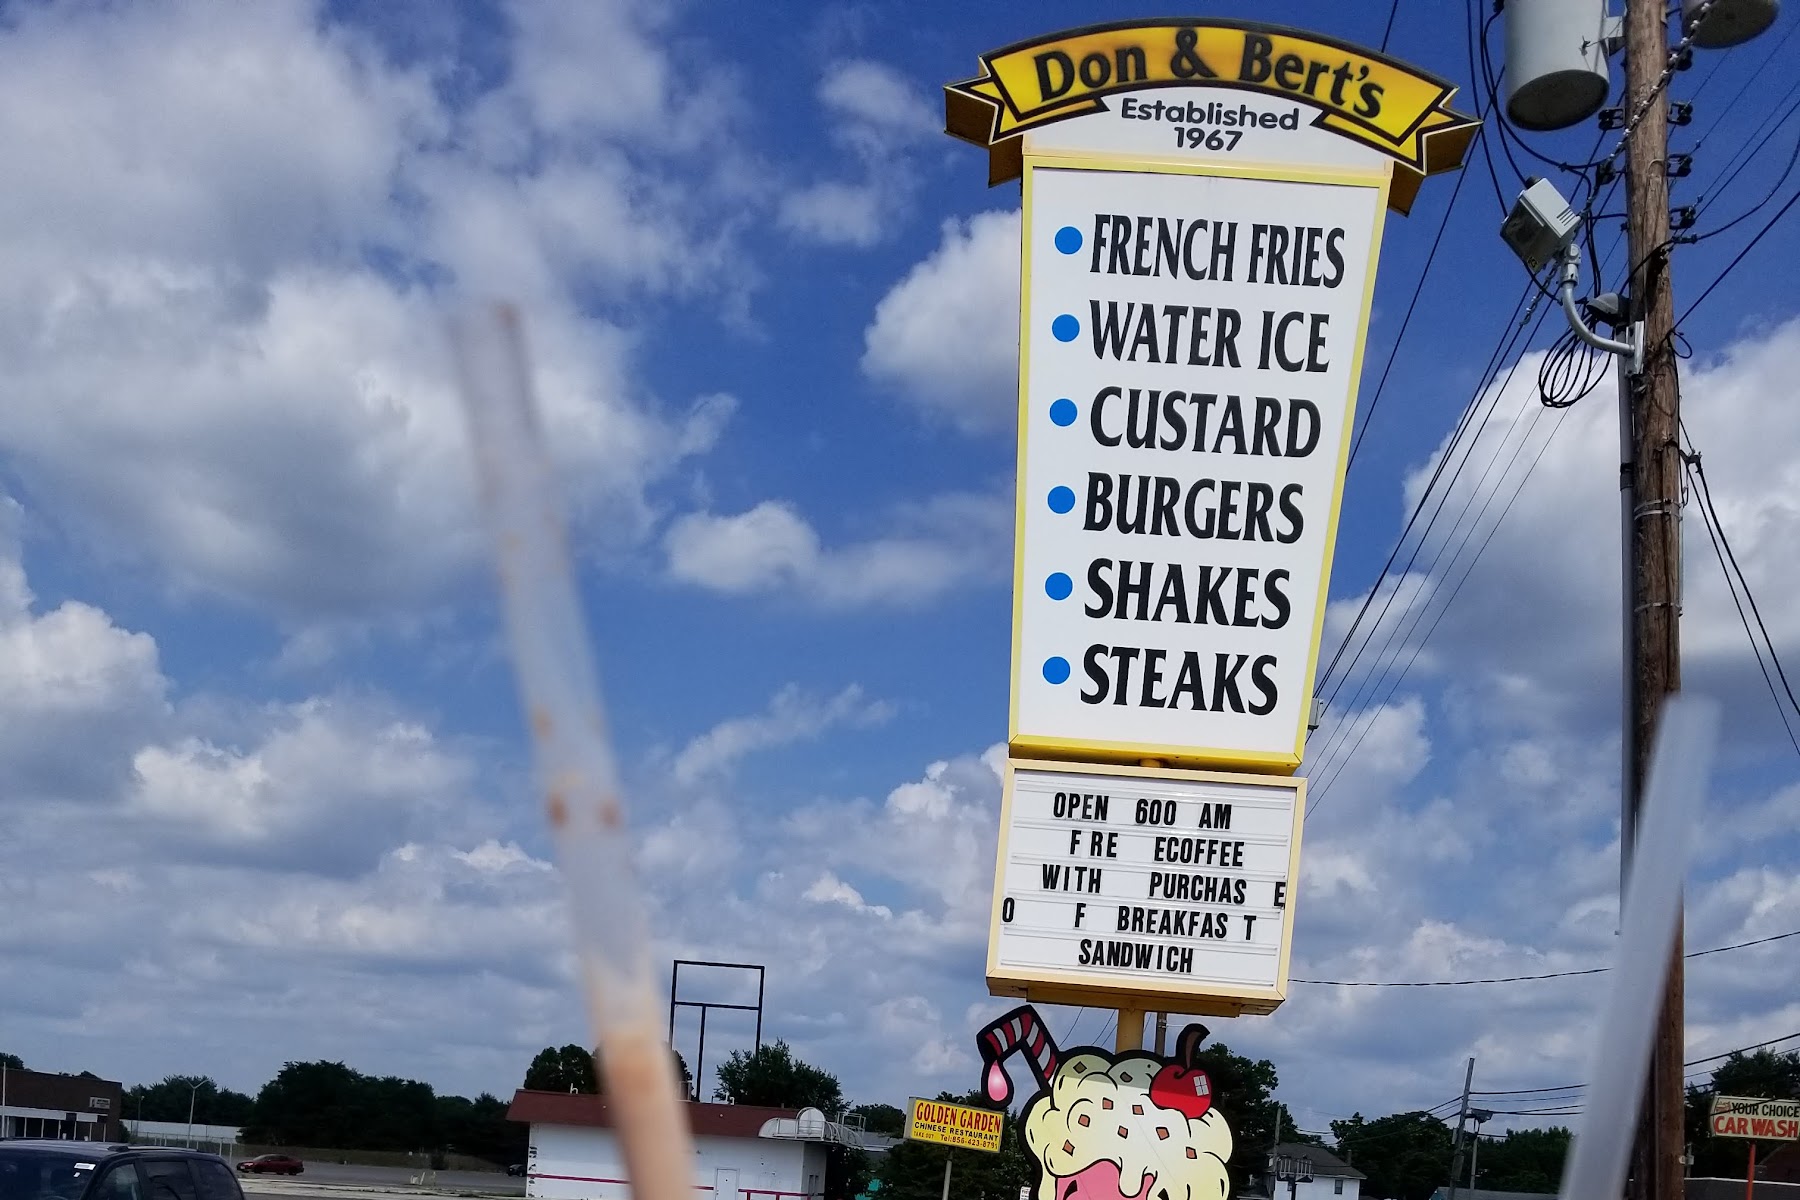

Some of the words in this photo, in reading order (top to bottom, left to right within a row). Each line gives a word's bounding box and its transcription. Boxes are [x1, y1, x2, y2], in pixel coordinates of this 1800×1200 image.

[1034, 45, 1147, 102] Don
[1170, 28, 1216, 78] &
[1239, 33, 1384, 119] Bert's
[1120, 98, 1299, 130] Established
[1174, 126, 1243, 151] 1967
[1090, 214, 1237, 281] FRENCH
[1247, 224, 1345, 289] FRIES
[1090, 300, 1241, 368] WATER
[1258, 310, 1329, 373] ICE
[1090, 386, 1321, 458] CUSTARD
[1082, 472, 1304, 544] BURGERS
[1084, 558, 1290, 629] SHAKES
[1080, 643, 1278, 716] STEAKS
[1053, 792, 1109, 821] OPEN
[1135, 799, 1176, 825] 600
[1199, 803, 1232, 830] AM
[1154, 837, 1244, 867] ECOFFEE
[1042, 864, 1101, 893] WITH
[1079, 939, 1194, 973] SANDWICH
[917, 1103, 957, 1126] GOLDEN
[961, 1110, 1000, 1133] GARDEN
[1714, 1116, 1748, 1135] CAR
[1751, 1118, 1799, 1137] WASH
[1732, 1102, 1759, 1115] YOUR
[1762, 1105, 1800, 1117] CHOICE
[915, 1122, 946, 1132] CHINESE
[950, 1128, 998, 1141] RESTAURANT
